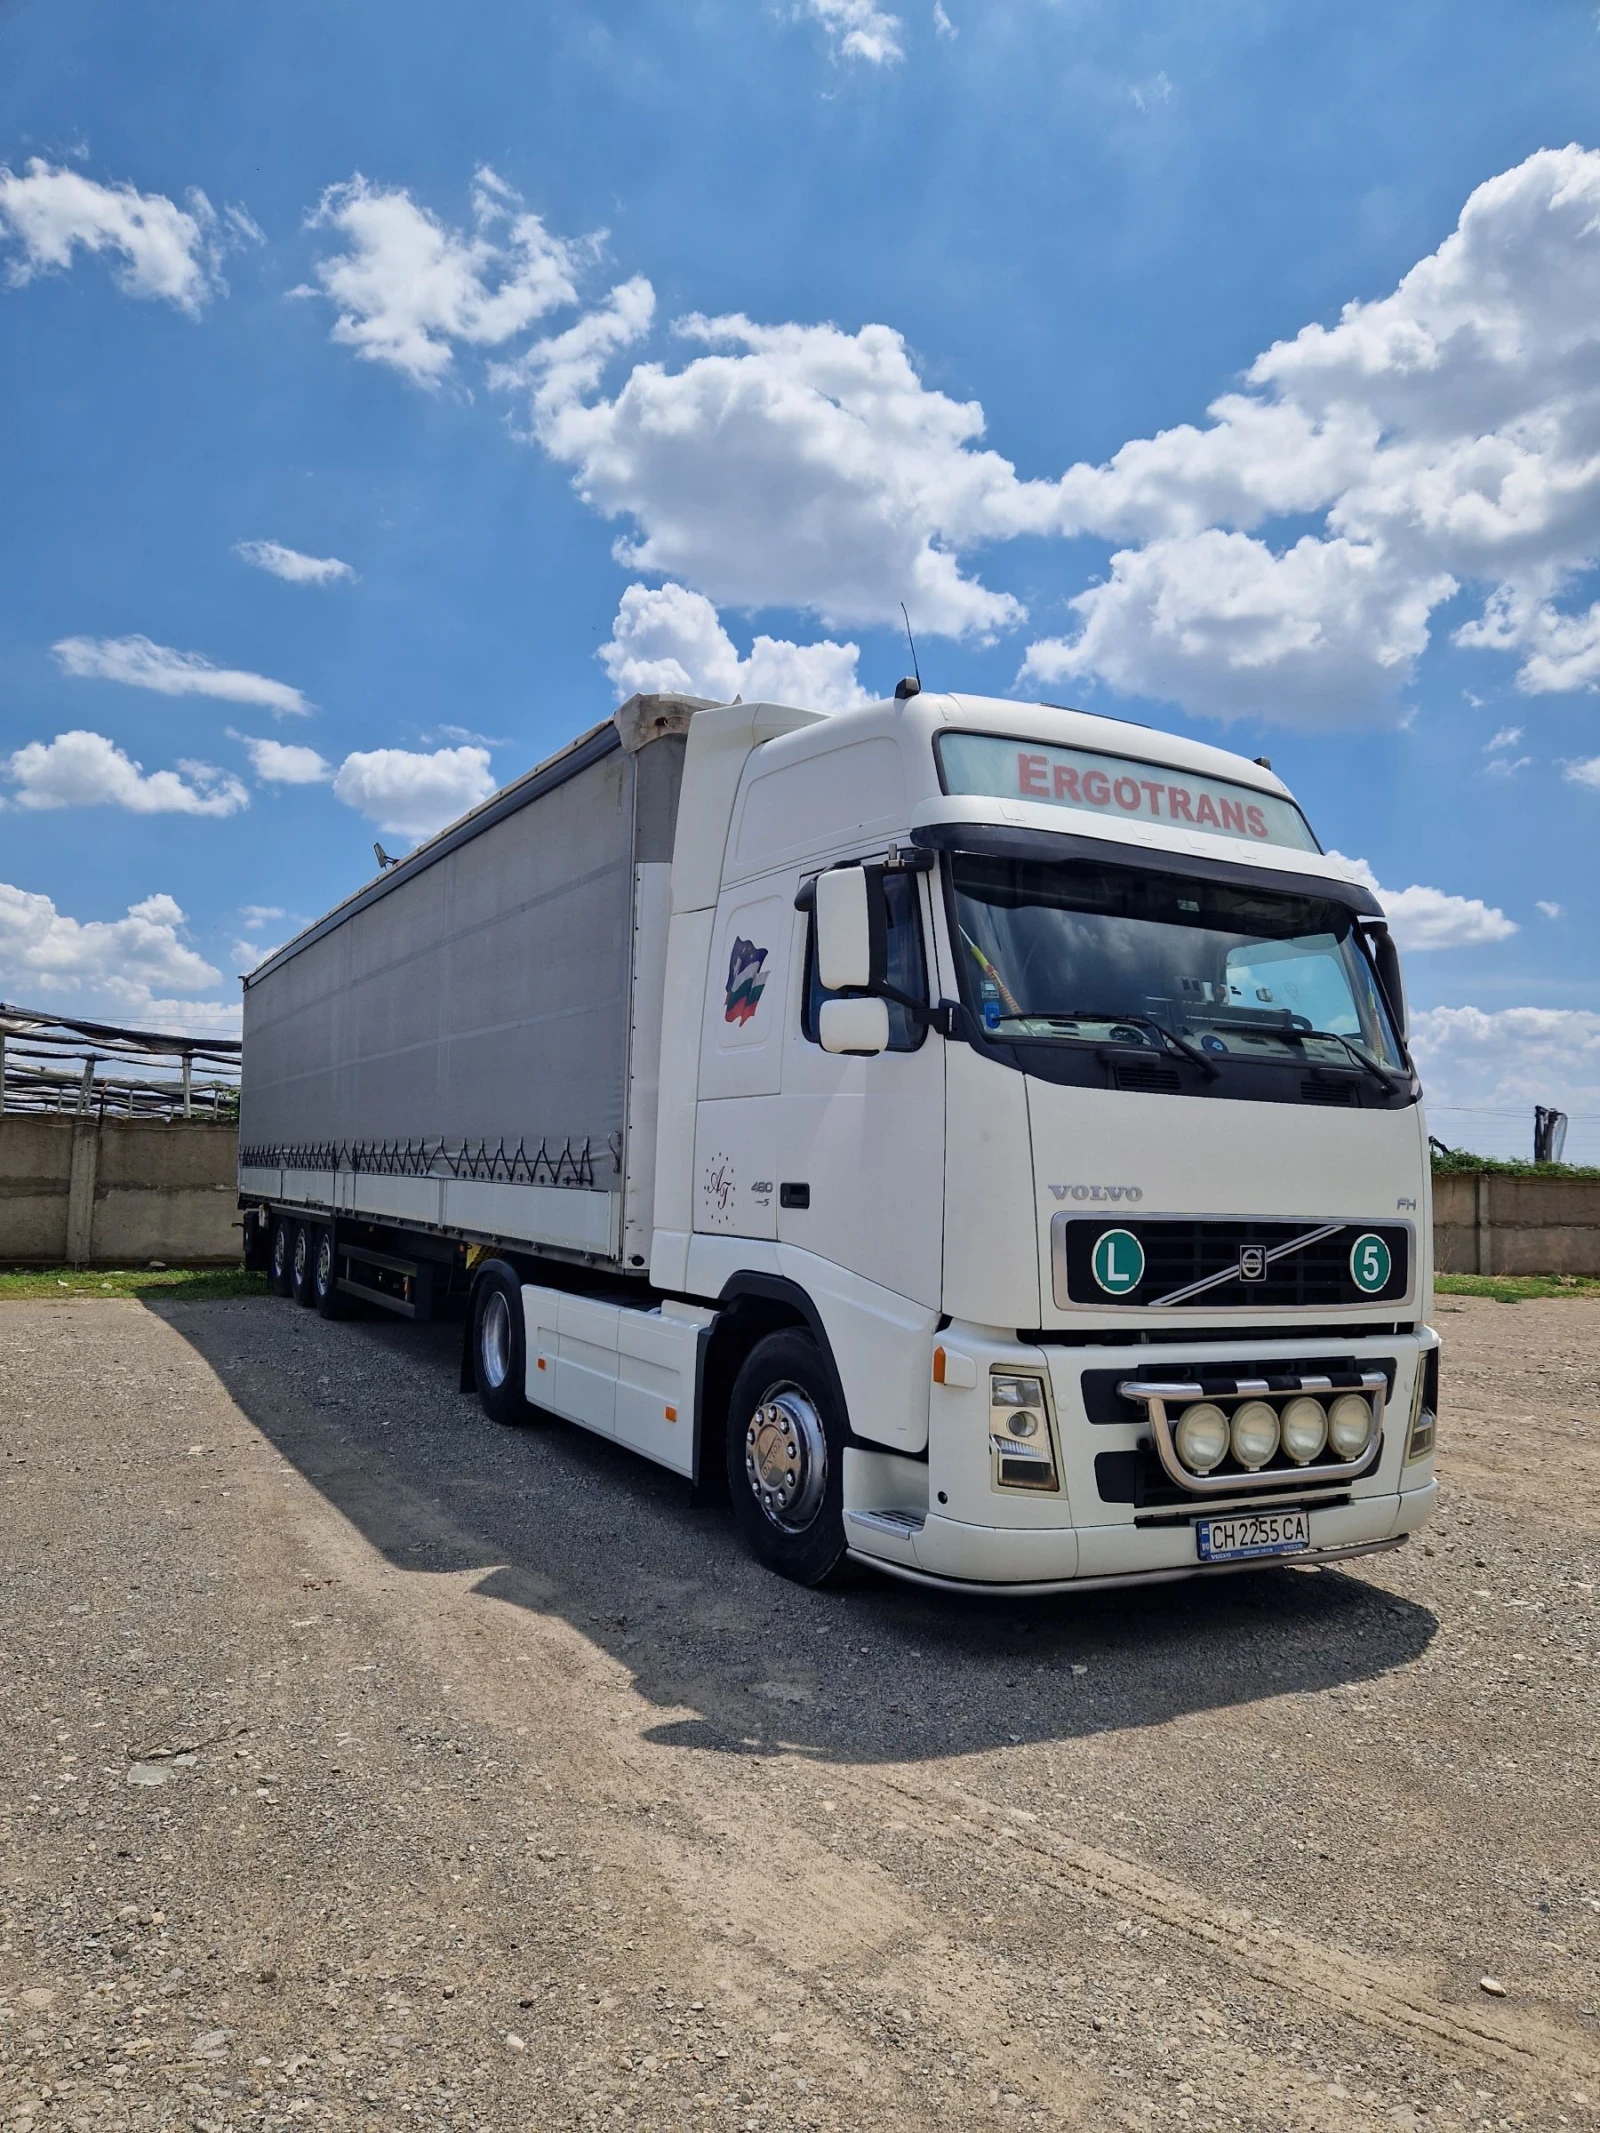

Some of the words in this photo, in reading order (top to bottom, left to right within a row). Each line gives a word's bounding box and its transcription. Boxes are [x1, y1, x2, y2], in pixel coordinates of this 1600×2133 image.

[1017, 753, 1269, 838] ERGOTRANS
[751, 1182, 773, 1193] 480
[1048, 1185, 1143, 1202] VOLVO
[1397, 1198, 1416, 1211] FH
[1108, 1242, 1130, 1281] L
[1362, 1246, 1379, 1281] 5
[762, 1437, 783, 1478] VOLVO
[1213, 1525, 1235, 1549] CH
[1239, 1519, 1280, 1546] 2255
[1283, 1517, 1305, 1540] CA
[1211, 1552, 1232, 1560] VOLVO
[1283, 1543, 1303, 1551] VOLVO
